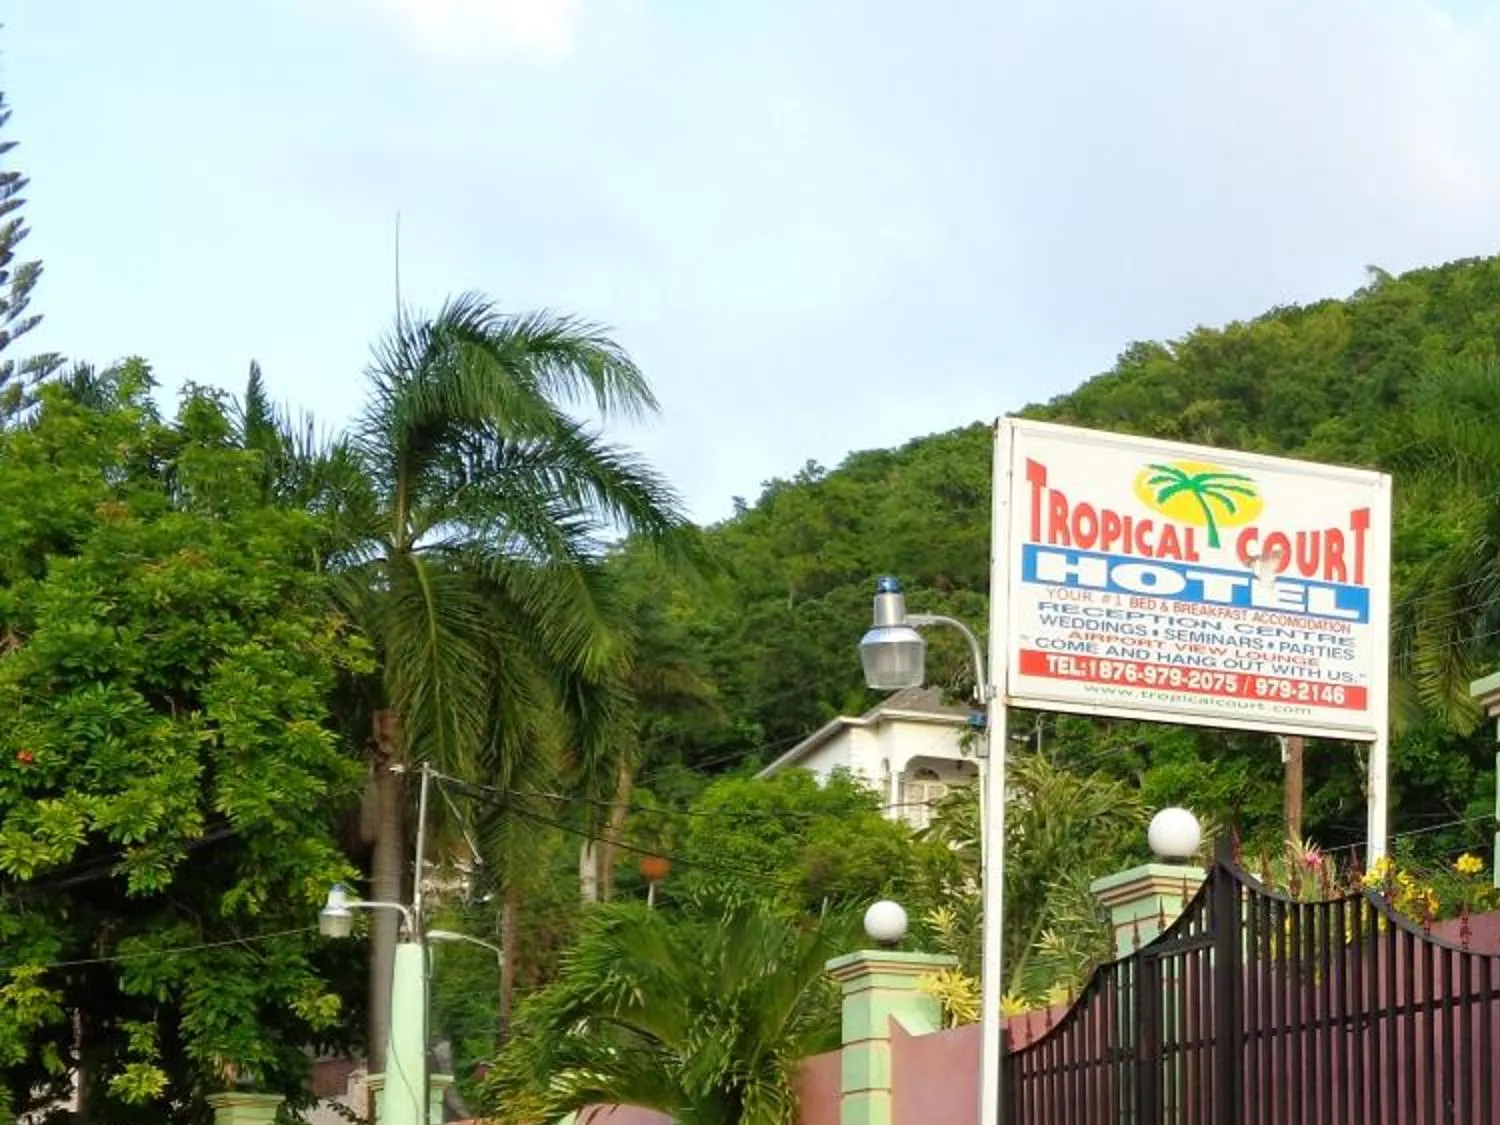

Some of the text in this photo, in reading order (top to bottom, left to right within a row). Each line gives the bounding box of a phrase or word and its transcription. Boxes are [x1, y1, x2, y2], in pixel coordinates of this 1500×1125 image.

[1026, 457, 1370, 585] TROPICAL COURT
[1036, 551, 1360, 620] HOTEL
[1047, 588, 1093, 601] YOUR
[1129, 597, 1156, 610] BED
[1173, 602, 1247, 621] BREAKFAST
[1038, 602, 1356, 647] RECEPTION CENTRE
[1040, 614, 1356, 661] WEDDINGS SEMINARS PARTIES
[1068, 631, 1320, 667] AIRPORT VIEW LOUNGE
[1105, 645, 1150, 660] AND
[1157, 651, 1217, 667] HANG
[1223, 659, 1266, 673] OUT
[1271, 664, 1321, 679] WITH
[1254, 678, 1346, 705] 979-2146
